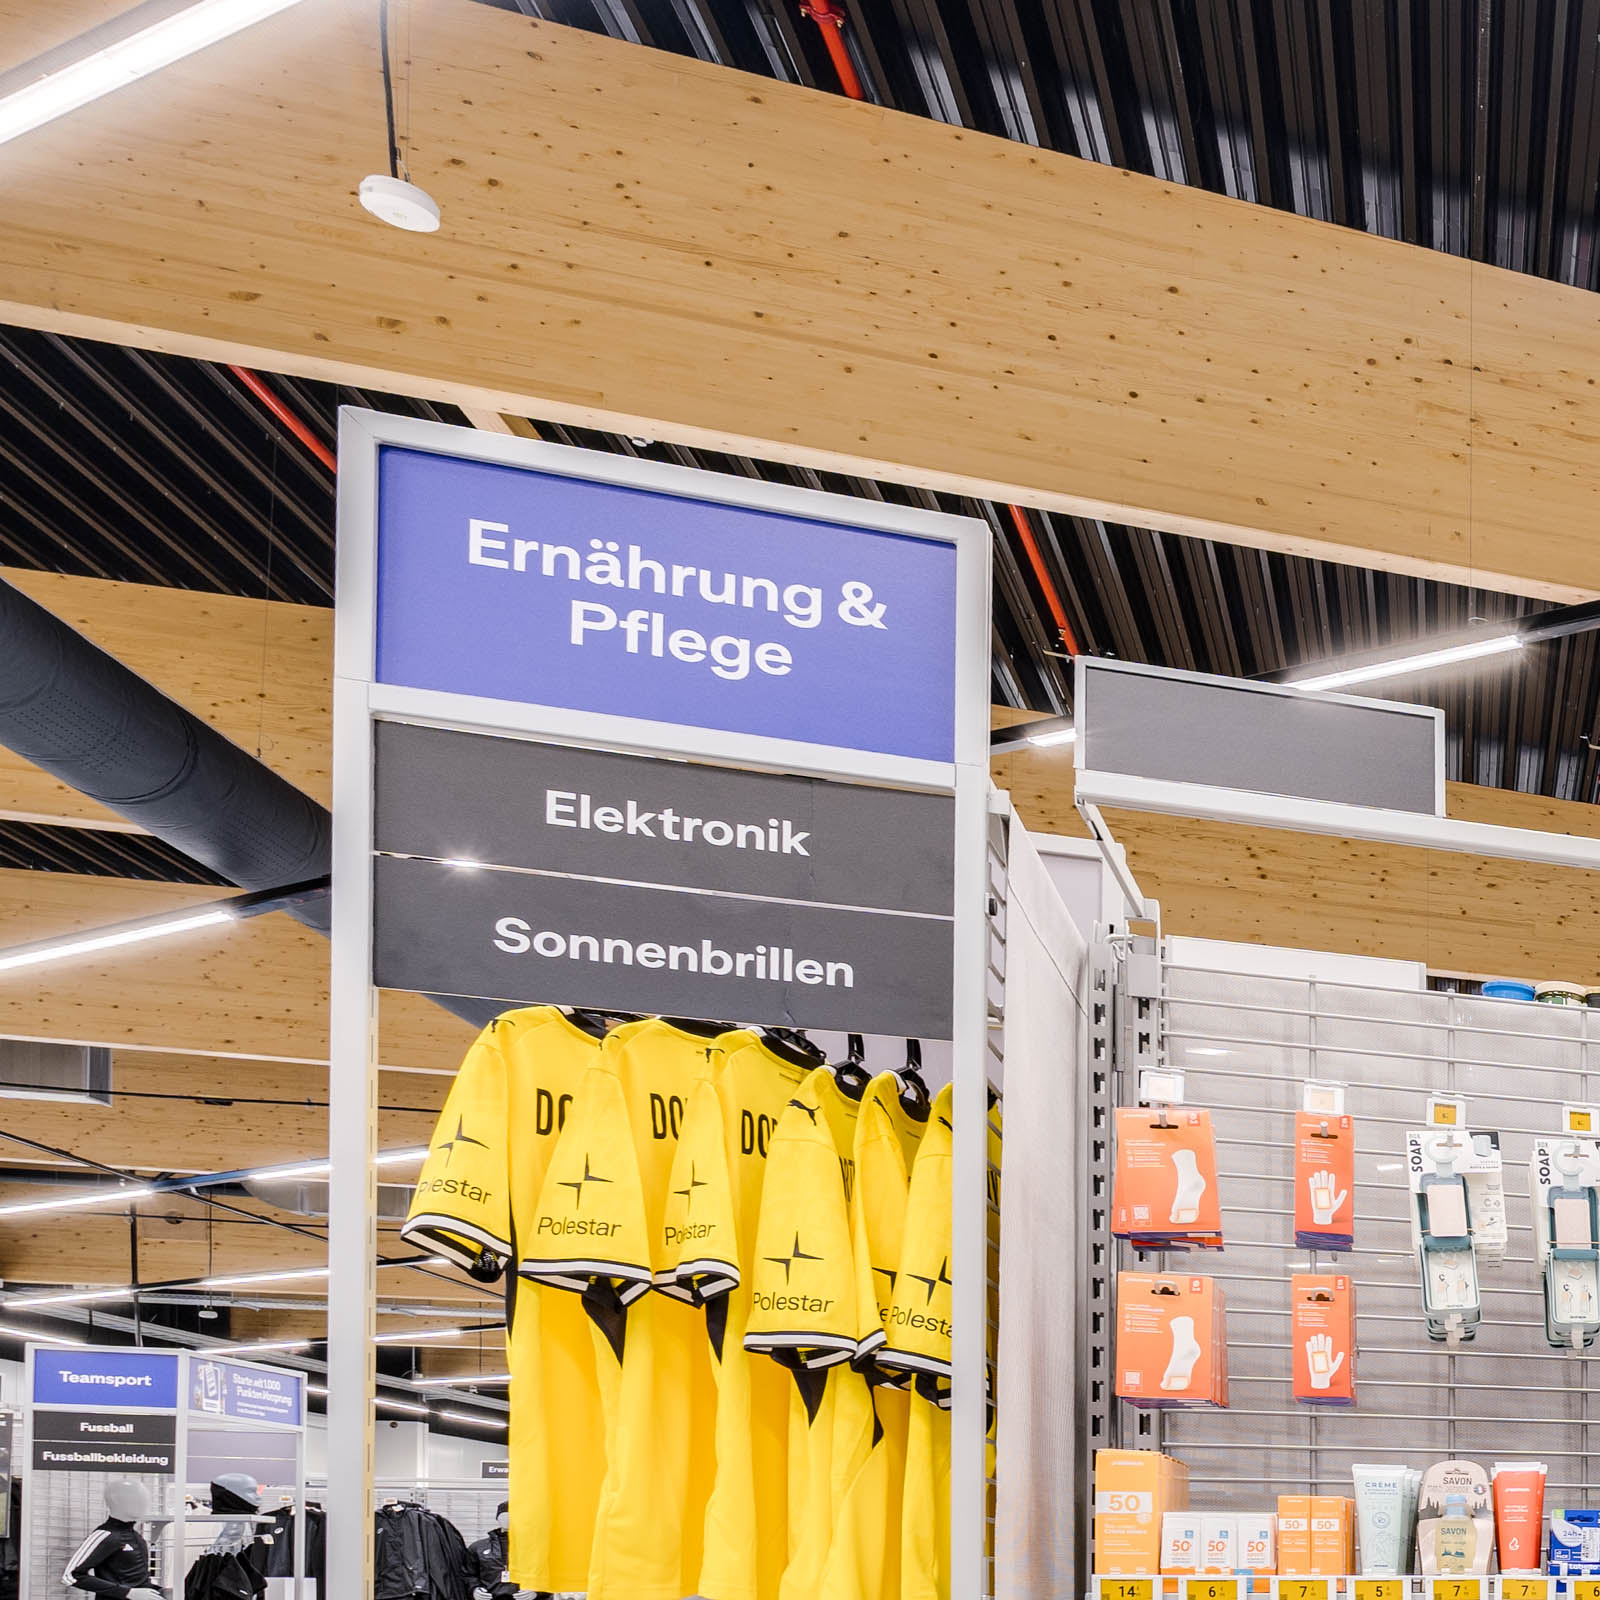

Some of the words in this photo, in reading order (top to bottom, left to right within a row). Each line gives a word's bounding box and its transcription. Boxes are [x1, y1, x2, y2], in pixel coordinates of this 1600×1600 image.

[468, 518, 823, 628] Ernährung
[838, 581, 888, 631] &
[571, 600, 793, 680] Pflege
[545, 790, 811, 857] Elektronik
[493, 916, 855, 989] Sonnenbrillen
[1412, 1139, 1422, 1172] SOAP
[1540, 1148, 1550, 1184] SOAP
[538, 1216, 622, 1237] Polestar
[754, 1292, 834, 1313] Polestar
[59, 1371, 152, 1388] Teamsport
[80, 1422, 133, 1433] Fussball
[43, 1452, 168, 1466] Fussballbekleidung
[1443, 1477, 1472, 1485] SAVON
[1110, 1495, 1140, 1510] 50
[1119, 1586, 1135, 1597] 14
[1209, 1586, 1216, 1597] 6
[1300, 1586, 1307, 1597] 7
[1376, 1586, 1383, 1597] 5
[1453, 1586, 1460, 1596] 7
[1521, 1585, 1528, 1596] 7
[1594, 1586, 1599, 1597] 6
